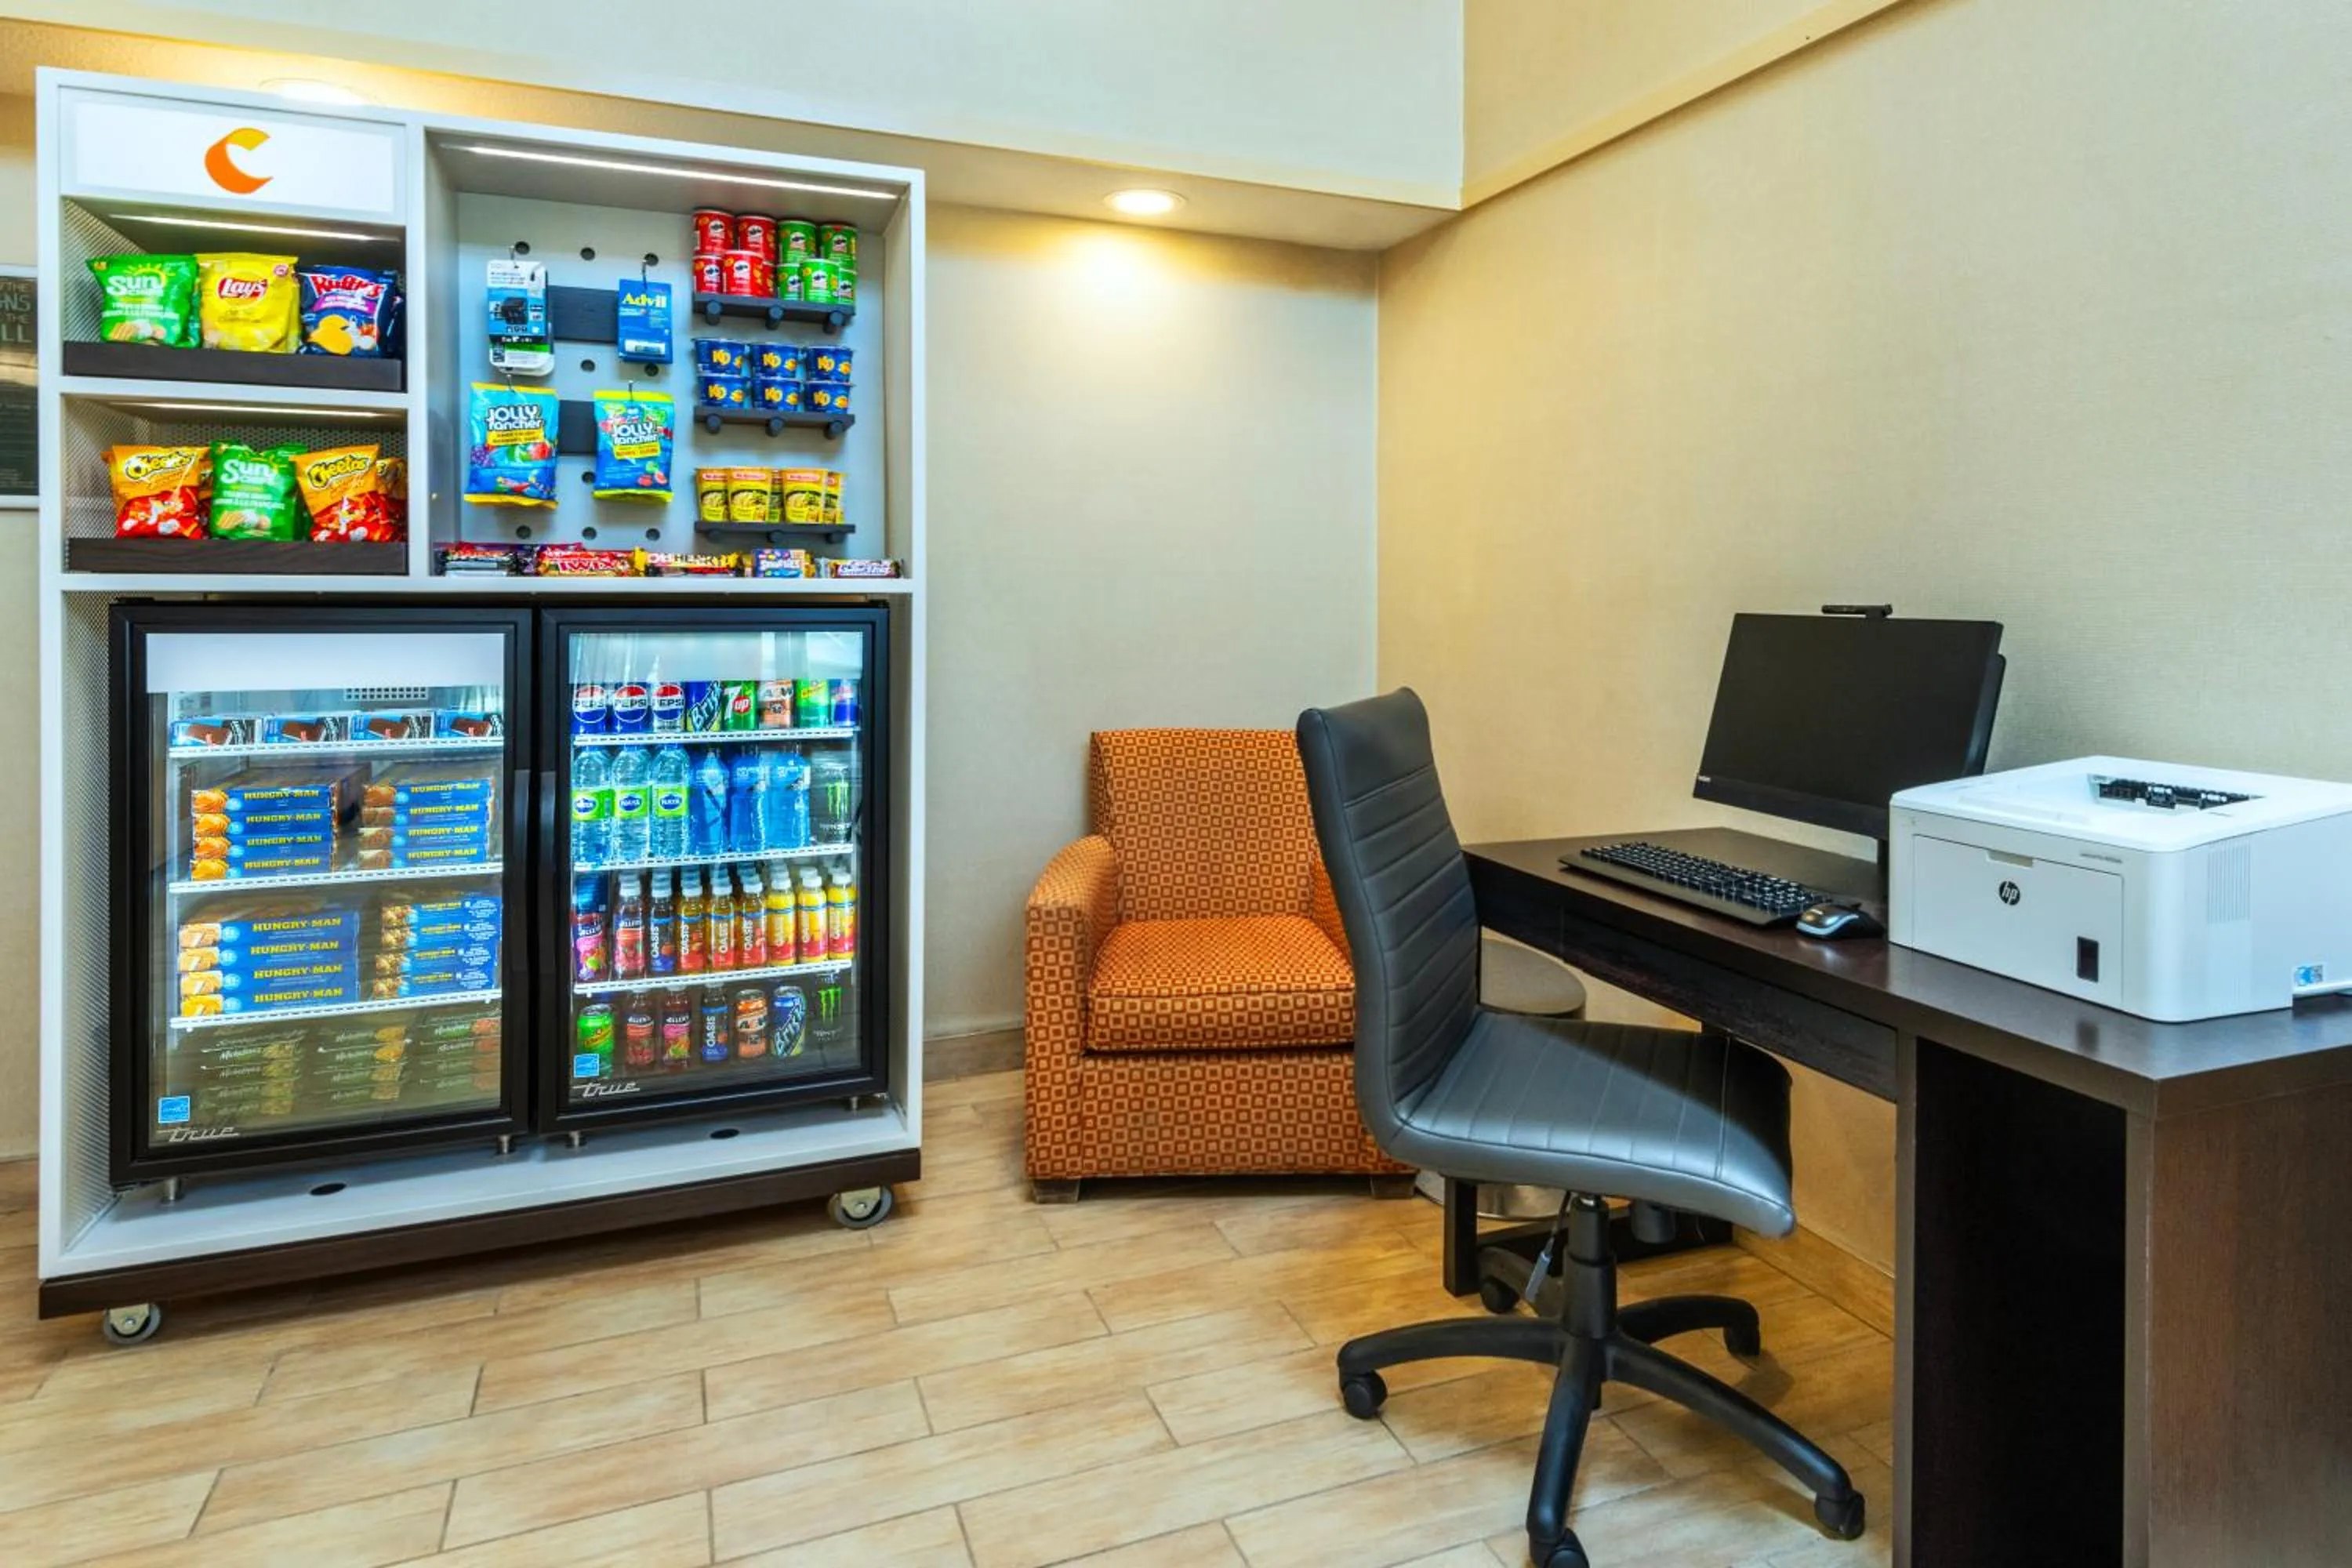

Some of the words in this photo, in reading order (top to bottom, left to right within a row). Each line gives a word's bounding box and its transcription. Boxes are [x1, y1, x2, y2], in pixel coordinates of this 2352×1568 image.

[107, 275, 162, 296] Sun
[622, 292, 666, 308] Advil
[488, 405, 539, 423] JOLLY
[220, 459, 272, 484] Sun
[2002, 880, 2018, 905] hp
[706, 1015, 715, 1047] OASIS
